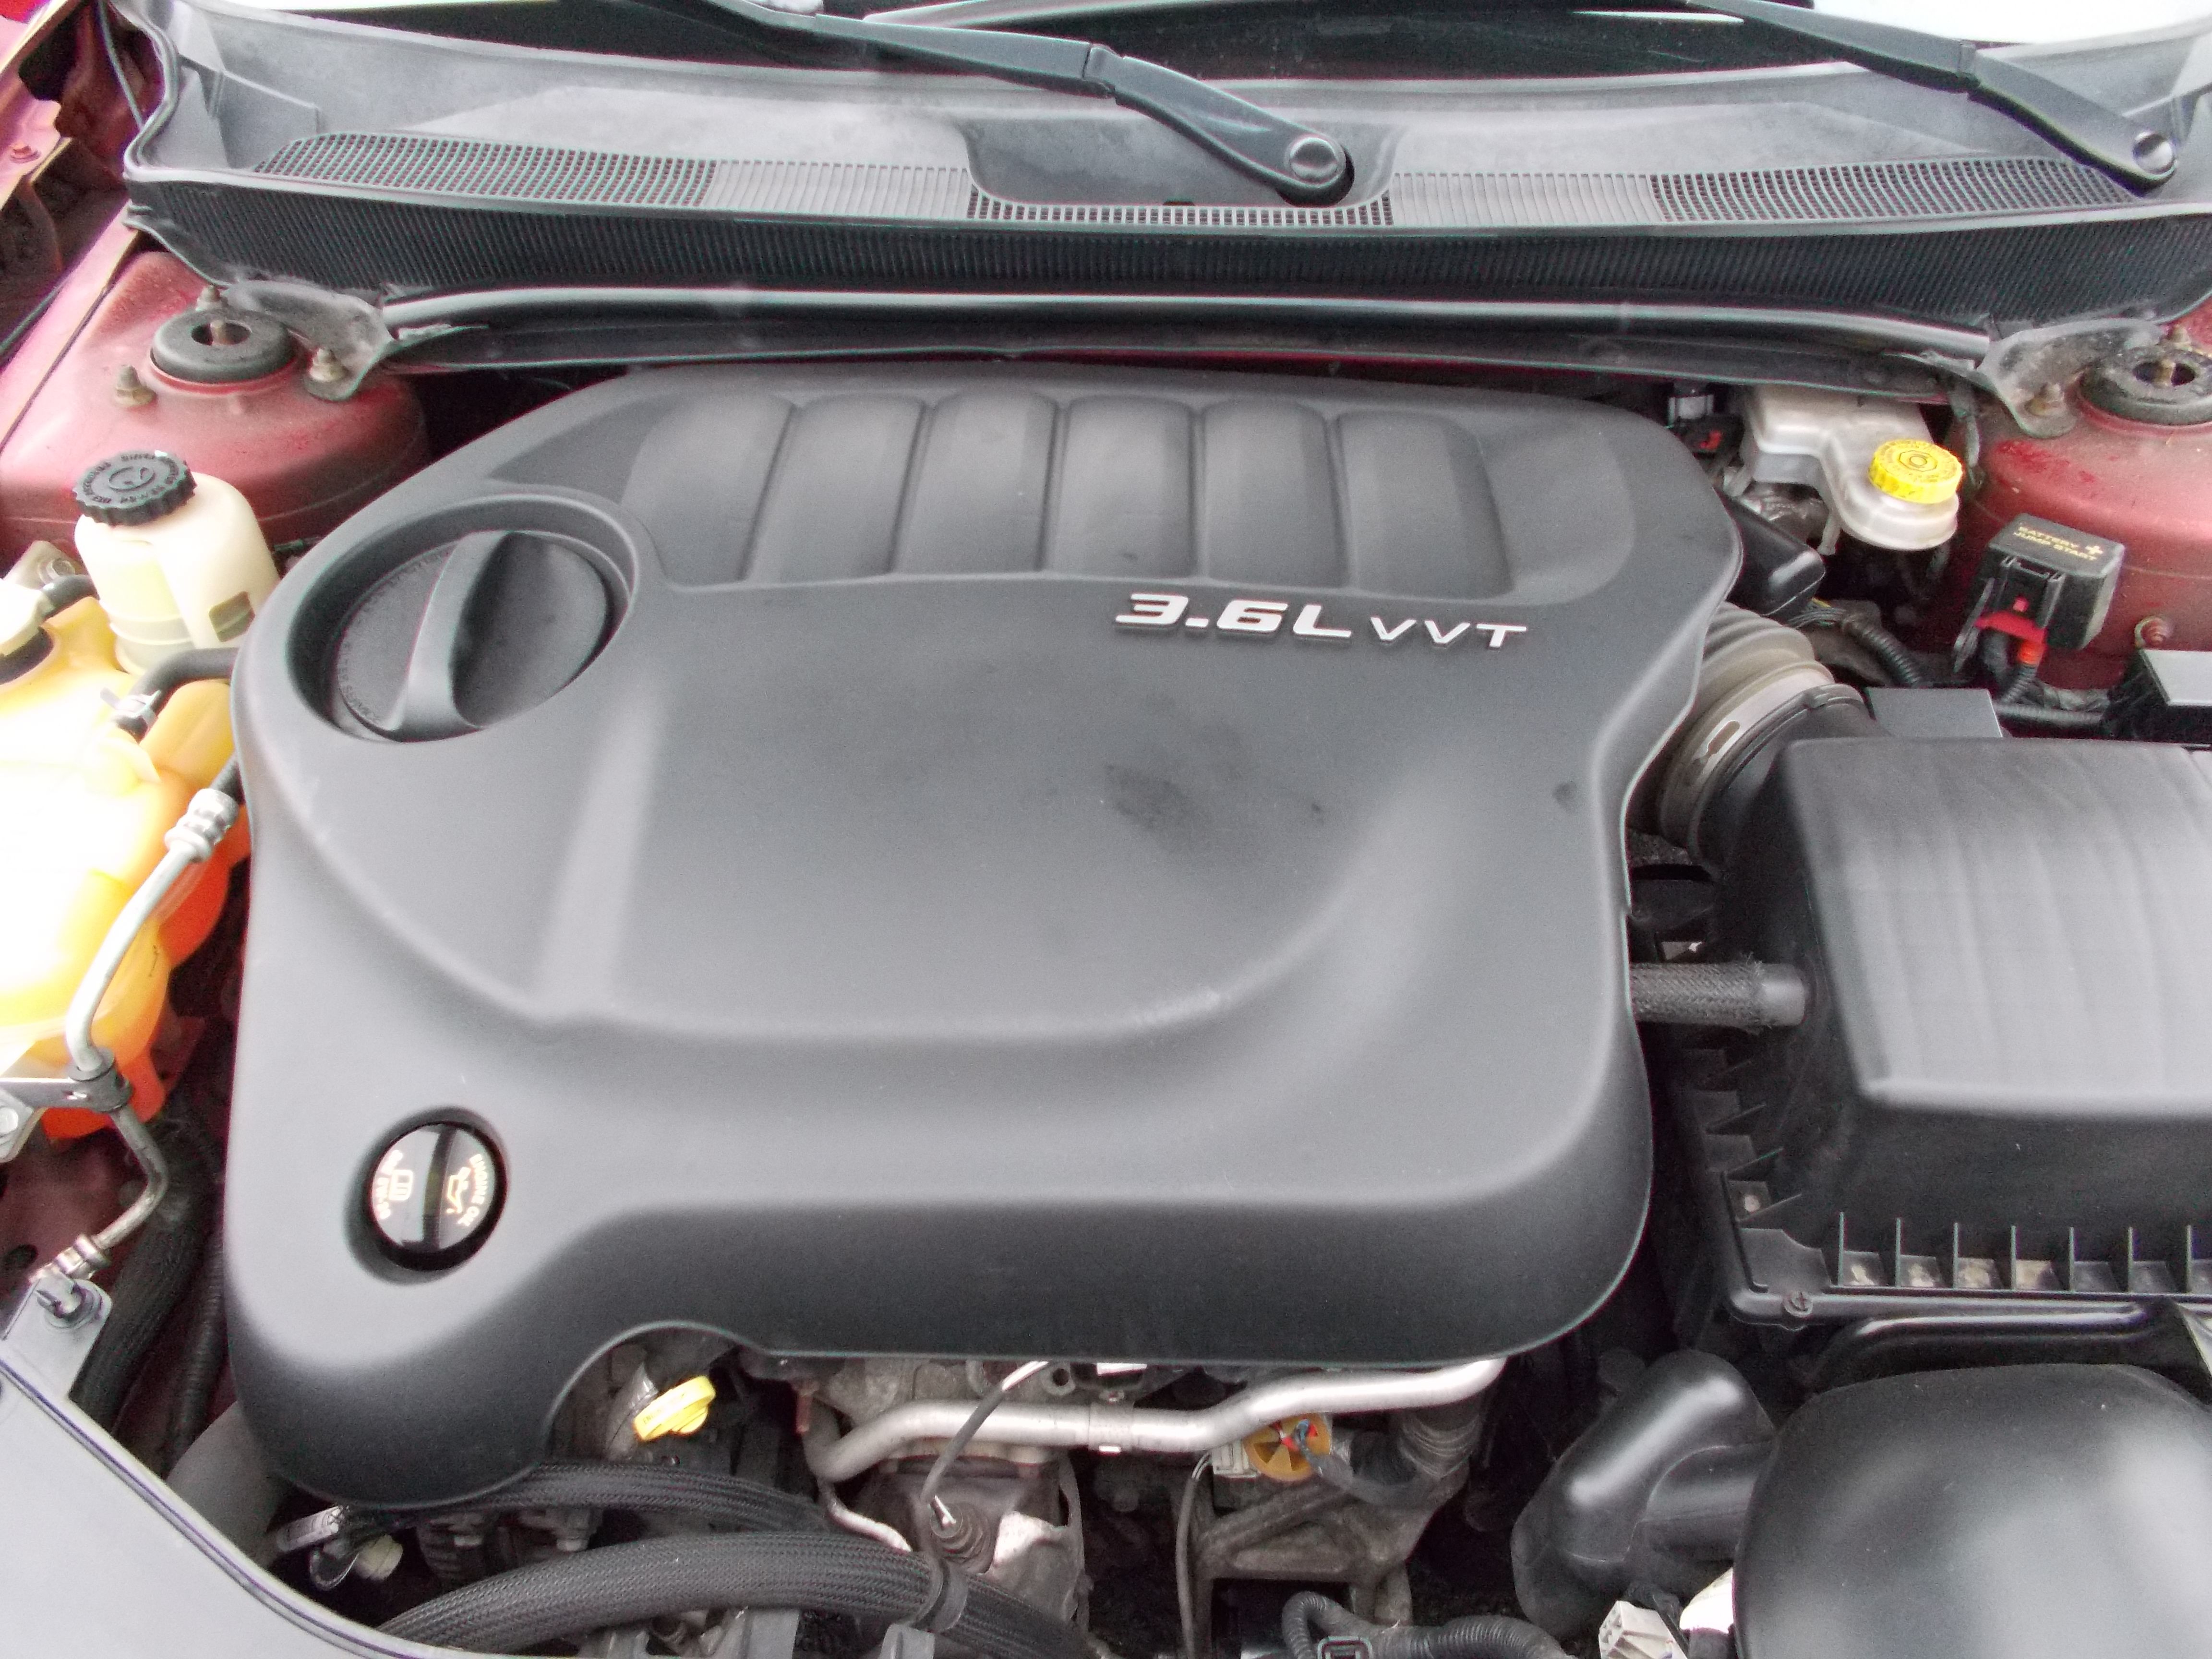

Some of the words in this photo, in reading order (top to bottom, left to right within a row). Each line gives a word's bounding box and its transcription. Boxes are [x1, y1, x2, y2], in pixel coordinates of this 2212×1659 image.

[1115, 593, 1352, 638] 3.6L
[1370, 616, 1527, 648] VVT
[469, 1153, 488, 1204] ENGINE
